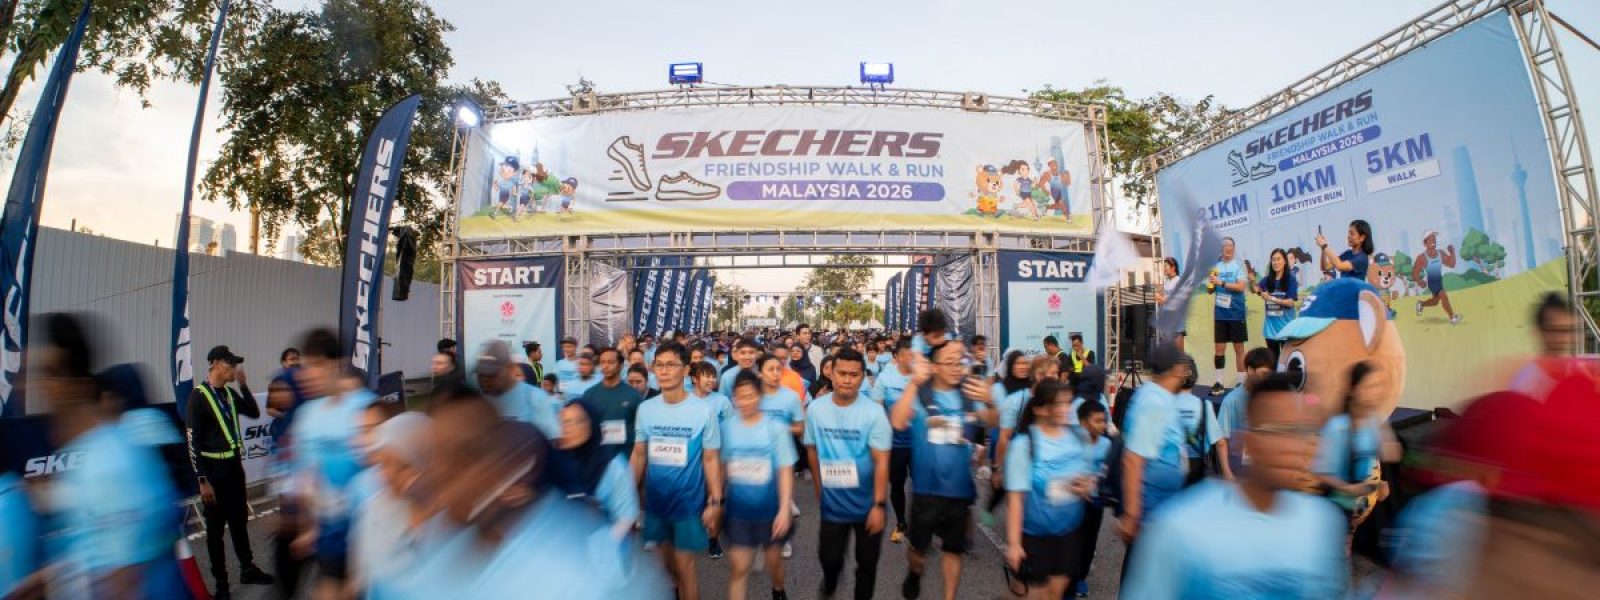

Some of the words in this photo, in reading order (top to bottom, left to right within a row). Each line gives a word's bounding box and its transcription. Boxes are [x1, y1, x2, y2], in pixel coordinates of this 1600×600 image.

[1245, 88, 1373, 159] SKECHERS
[1267, 135, 1317, 162] FRIENDSHIP
[1319, 126, 1346, 143] WALK
[1356, 112, 1378, 128] RUN
[652, 129, 944, 159] SKECHERS
[1292, 143, 1337, 166] MALAYSIA
[1340, 133, 1364, 149] 2026
[1366, 133, 1433, 175] 5KM
[704, 162, 821, 177] FRIENDSHIP
[830, 162, 883, 177] WALK
[888, 163, 899, 176] &
[906, 163, 944, 177] RUN
[1271, 165, 1336, 203] 10KM
[1388, 170, 1417, 184] WALK
[761, 183, 862, 198] MALAYSIA
[866, 184, 913, 198] 2026
[1271, 195, 1322, 216] COMPETITIVE
[1323, 190, 1343, 203] RUN
[351, 138, 394, 372] SKECHERS
[1018, 260, 1087, 278] START
[474, 265, 545, 285] START
